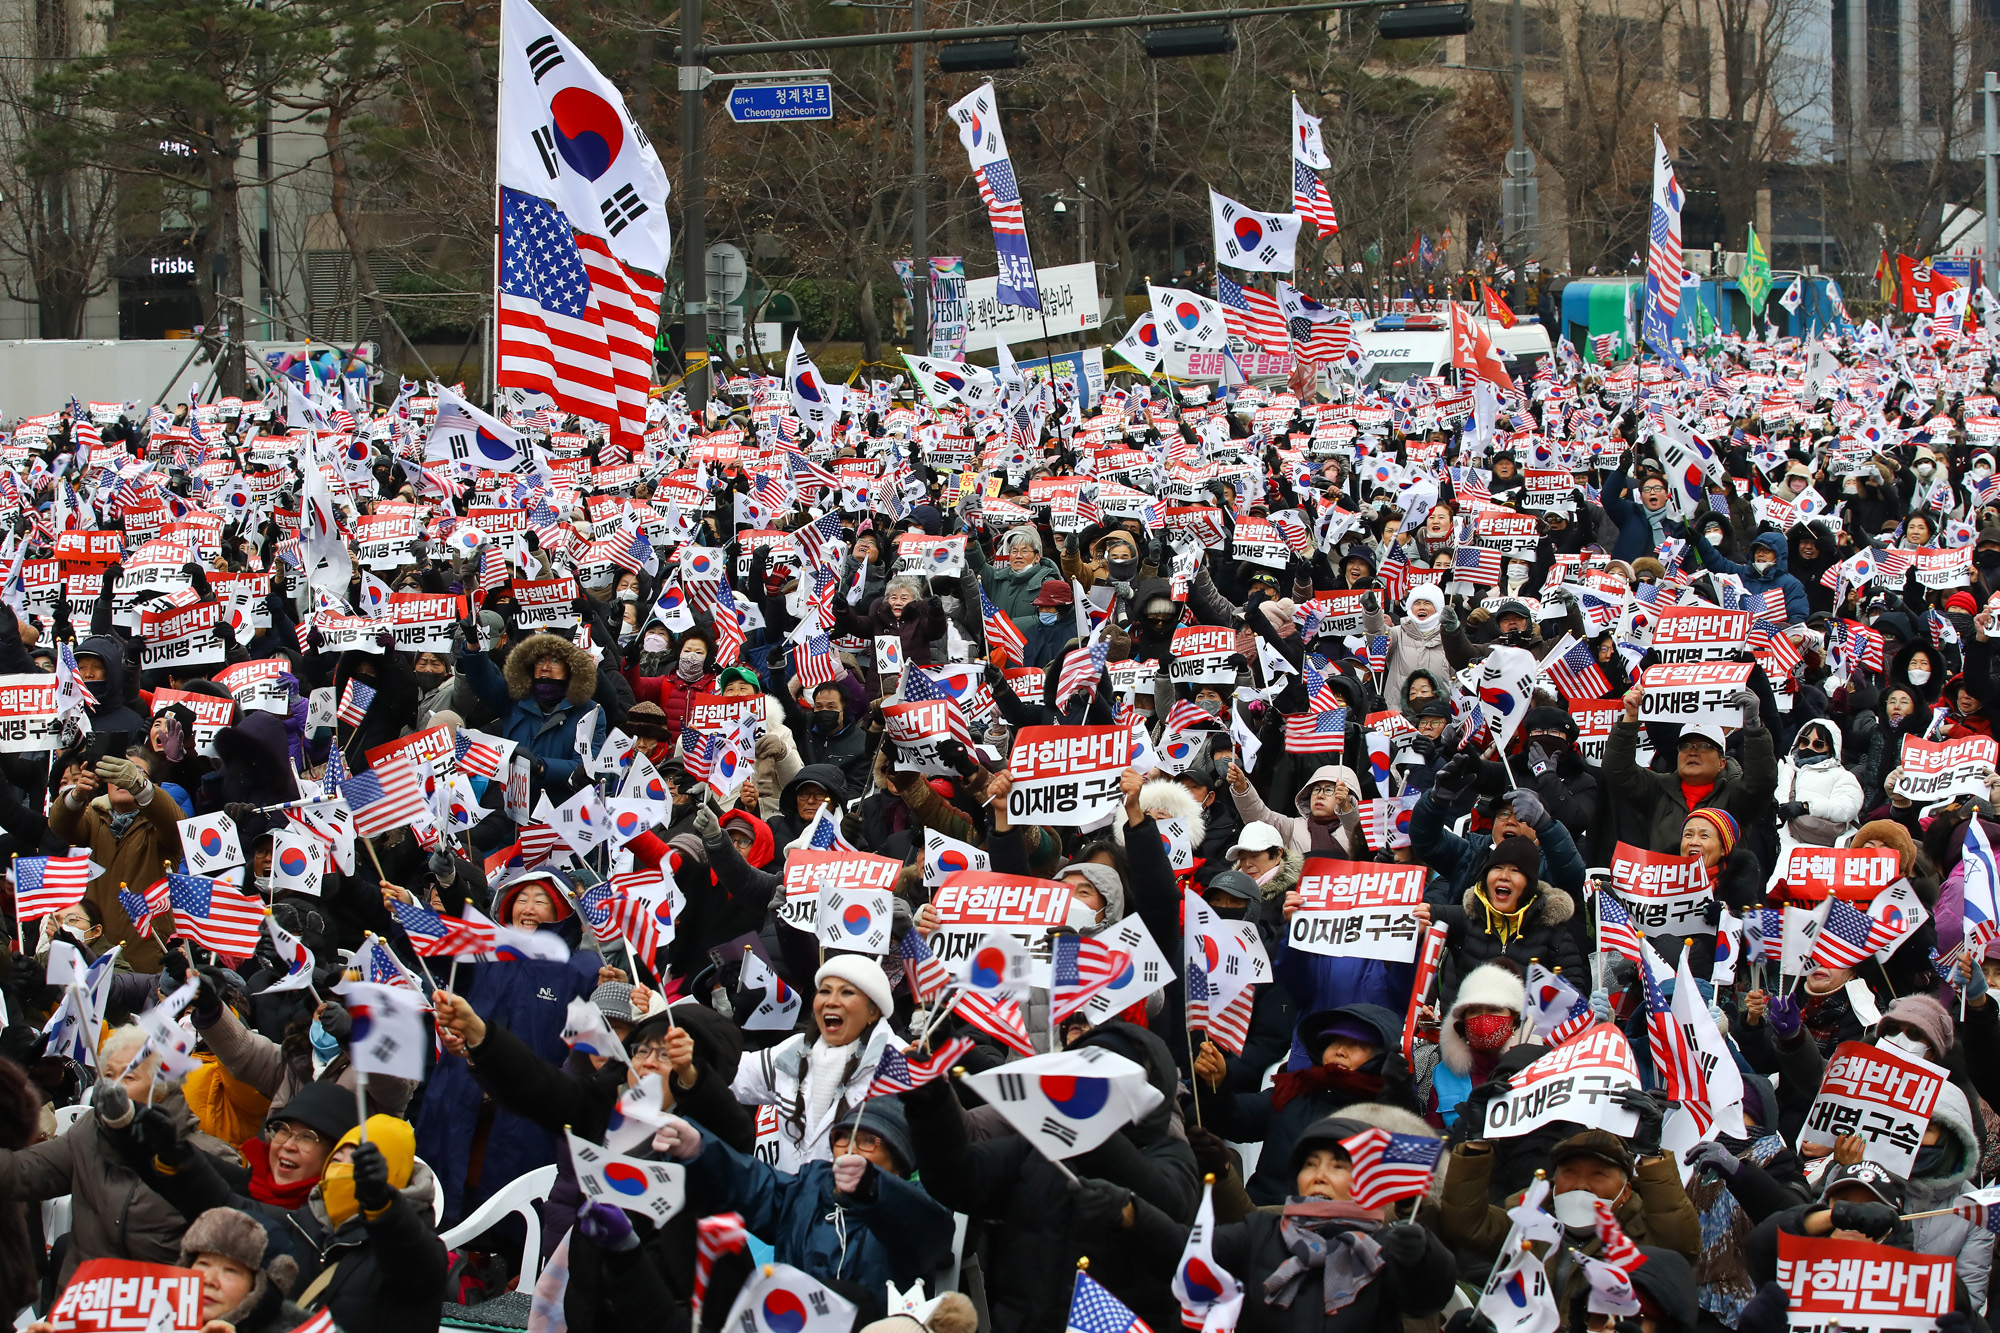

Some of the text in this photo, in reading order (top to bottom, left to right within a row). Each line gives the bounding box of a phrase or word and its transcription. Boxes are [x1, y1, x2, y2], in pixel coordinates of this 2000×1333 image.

[776, 88, 827, 104] 청계천로
[744, 106, 828, 118] Cheonggyecheon-ro
[934, 278, 967, 300] WINTER
[936, 300, 964, 322] FESTA
[1367, 348, 1411, 358] POLICE
[1255, 410, 1294, 421] 탄핵반대
[551, 436, 590, 448] 탄핵반대
[1318, 424, 1357, 439] 탄핵반대
[90, 440, 128, 460] 탄핵반대
[1314, 440, 1338, 452] 이재명
[1097, 451, 1148, 472] 탄핵반대
[593, 464, 640, 486] 탄핵반대
[1524, 472, 1574, 491] 탄핵반대
[655, 486, 707, 506] 탄핵반대
[1524, 494, 1554, 506] 이재명
[124, 512, 170, 530] 탄핵반대
[358, 520, 416, 542] 탄핵반대
[466, 512, 526, 534] 탄핵반대
[1479, 518, 1538, 536] 탄핵반대
[58, 534, 121, 554] 탄핵 반대
[357, 542, 391, 560] 이재명
[1232, 544, 1290, 562] 이재명 구속
[123, 545, 194, 568] 탄핵반대
[1916, 547, 1971, 571] 탄핵반대
[23, 561, 60, 584] 반대
[68, 574, 104, 594] 탄핵
[115, 570, 158, 590] 이재명
[514, 578, 580, 604] 탄핵반대
[388, 598, 456, 624] 탄핵반대
[144, 608, 221, 638] 탄핵반대
[1320, 617, 1352, 634] 이재명
[1653, 616, 1746, 644] 탄핵반대
[143, 632, 224, 666] 이재명 구속
[1170, 630, 1236, 652] 탄핵반대
[1171, 657, 1204, 678] 이재명
[1642, 664, 1754, 688] 탄핵반대
[1008, 674, 1046, 696] 탄핵반
[152, 698, 235, 725] 탄반대
[1642, 690, 1700, 715] 이재명
[1572, 709, 1613, 736] 탄핵
[1010, 730, 1128, 778] 탄핵반대
[1904, 739, 1998, 771] 탄핵반대
[1900, 770, 1954, 795] 이재명
[1010, 784, 1079, 818] 이재명
[786, 859, 899, 894] 탄핵반대
[1612, 854, 1711, 895] 탄핵반대
[1788, 856, 1896, 886] 탄핵 반대
[1301, 870, 1421, 908] 탄핵반대
[936, 886, 1070, 922] 탄핵반대
[1293, 914, 1417, 945] 이재명 구속
[929, 932, 988, 962] 이재
[1826, 1056, 1939, 1115] 핵반대
[1489, 1076, 1575, 1129] 이재명
[1862, 1111, 1922, 1156] 구속
[1846, 1160, 1892, 1184] Callaway
[1777, 1258, 1953, 1315] 탄핵반대
[52, 1276, 202, 1330] 탄핵반대
